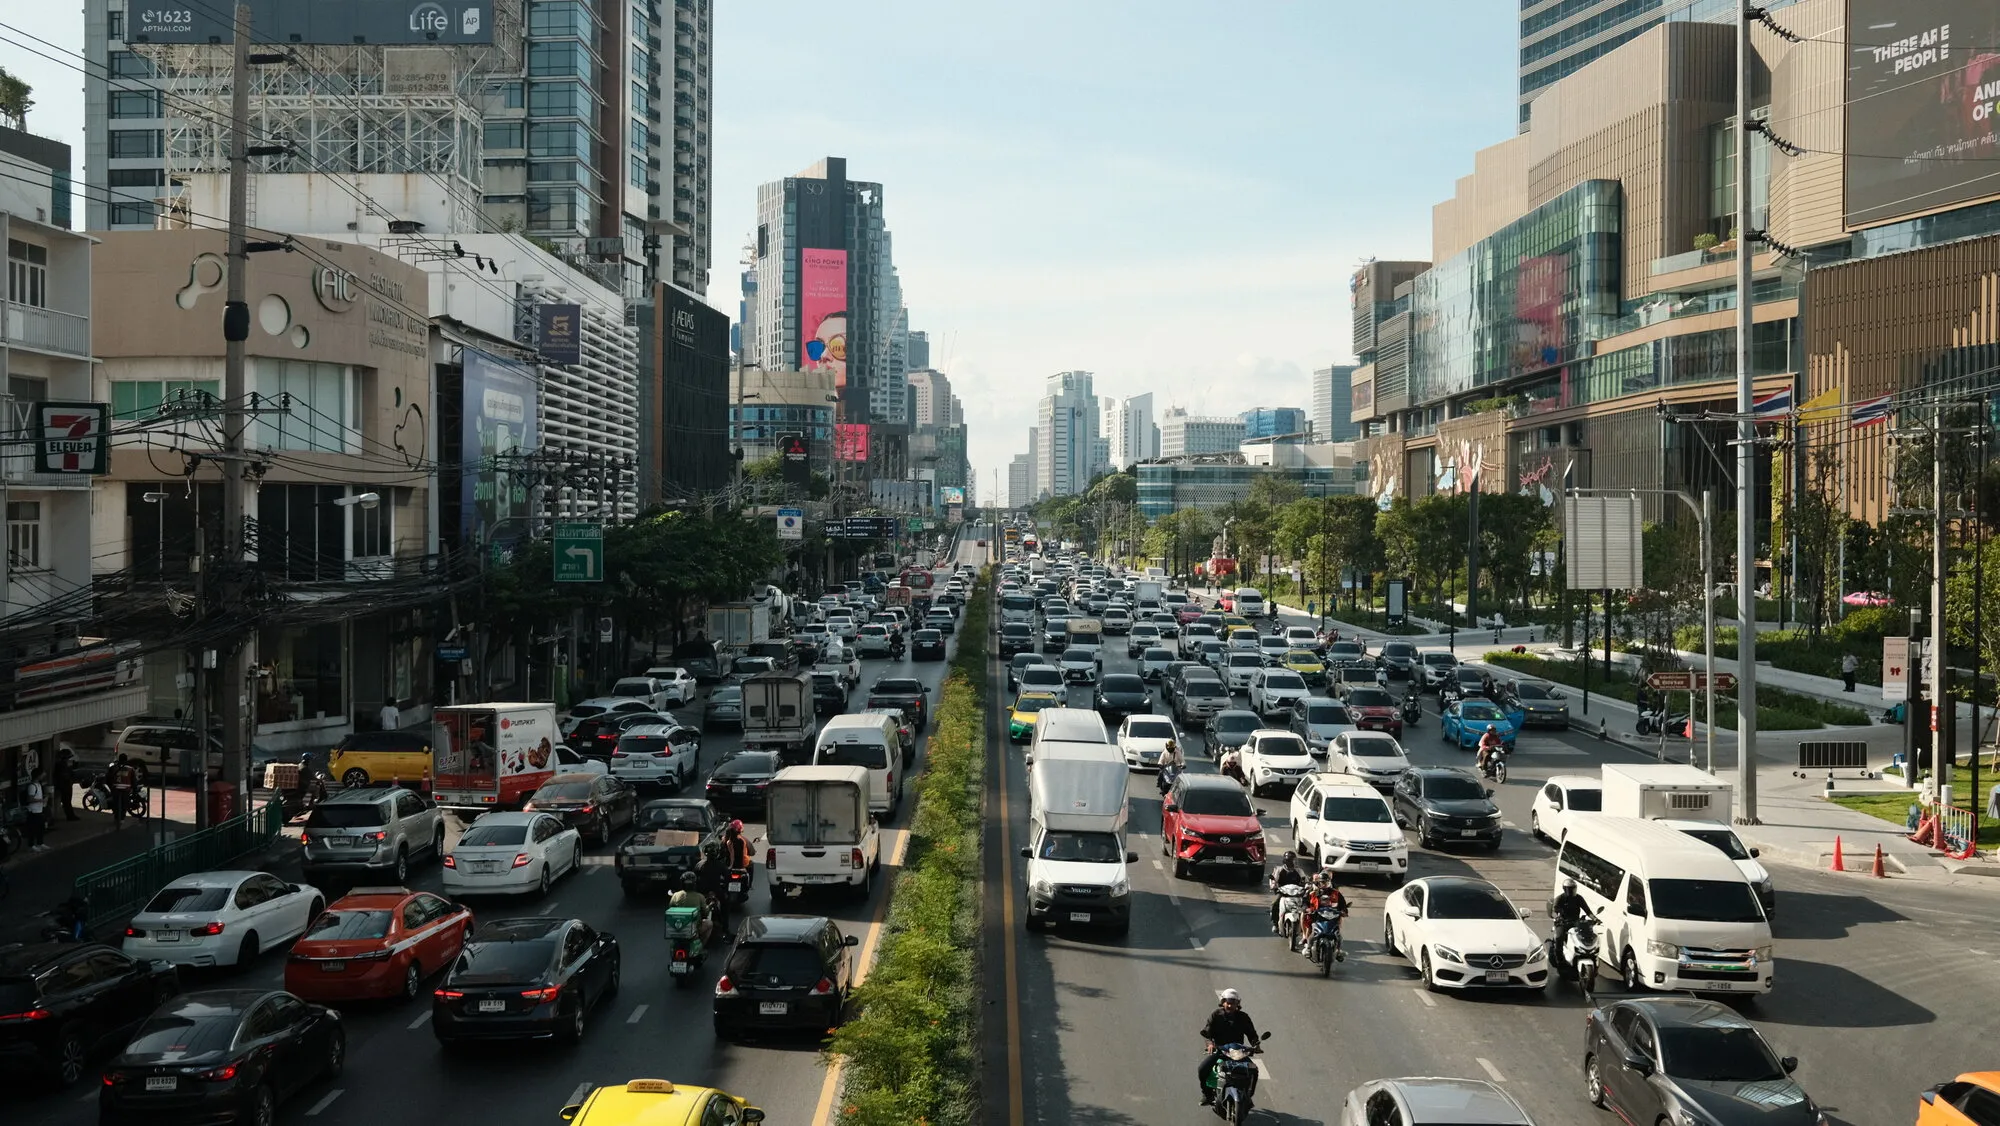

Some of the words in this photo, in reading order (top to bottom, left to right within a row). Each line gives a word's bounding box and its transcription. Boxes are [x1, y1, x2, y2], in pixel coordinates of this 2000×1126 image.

[156, 10, 192, 23] 1623
[408, 10, 449, 31] Life
[465, 17, 478, 26] AP
[142, 25, 192, 33] APTHAI.COM
[1872, 34, 1918, 64] THERE
[1920, 24, 1950, 47] ARE
[1895, 43, 1950, 76] PEOPLE
[1973, 101, 1993, 121] OF
[822, 258, 844, 266] POWER
[676, 309, 695, 330] AETAS
[510, 718, 536, 727] PUMPKIN
[1071, 886, 1092, 894] ISUZU
